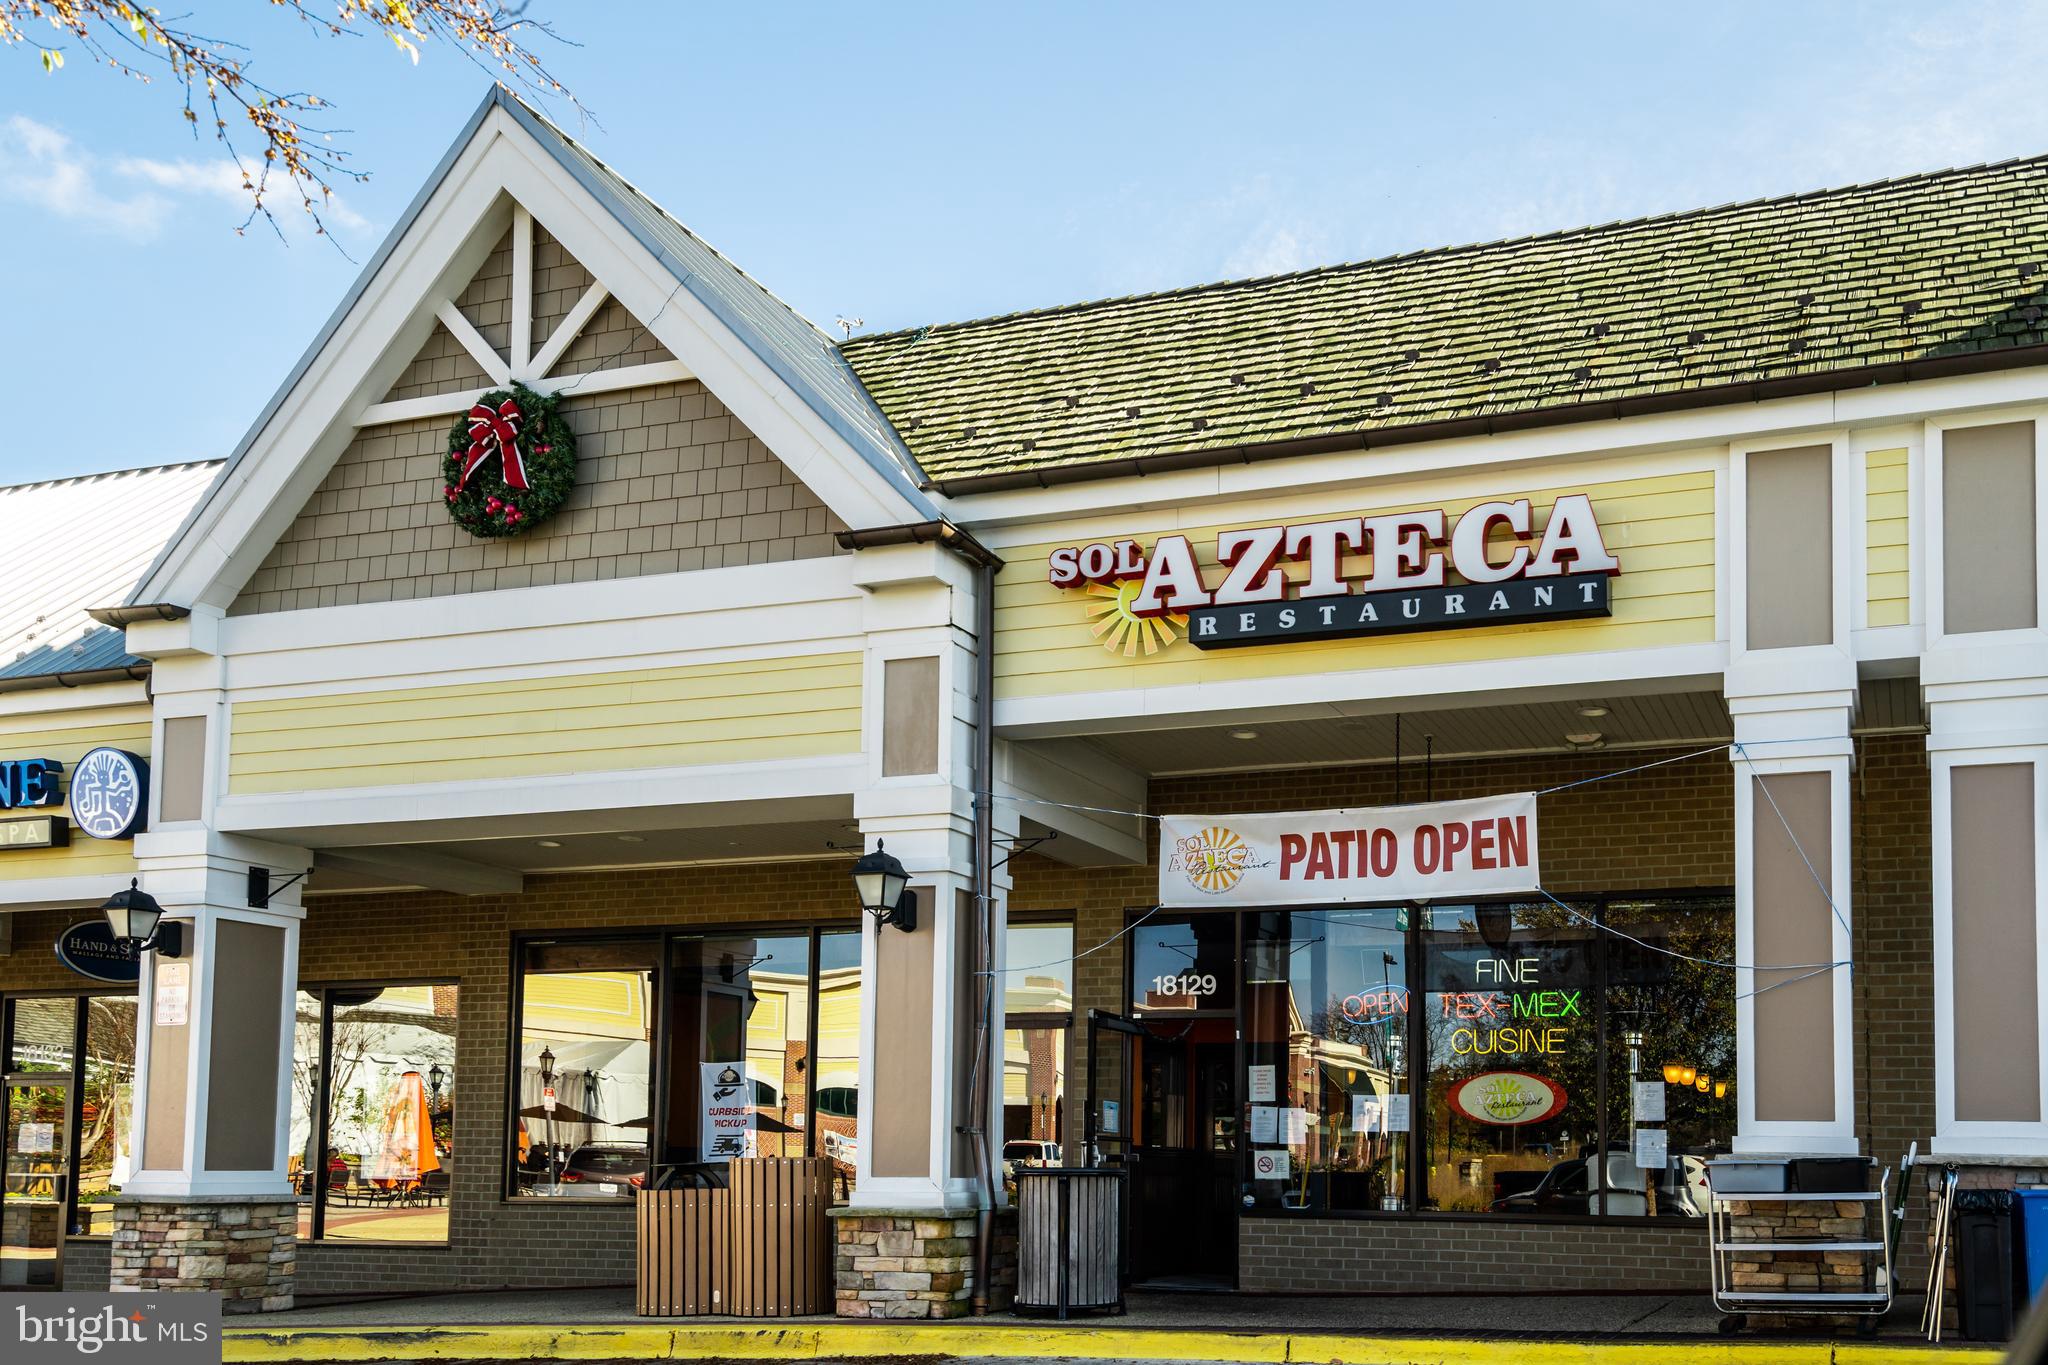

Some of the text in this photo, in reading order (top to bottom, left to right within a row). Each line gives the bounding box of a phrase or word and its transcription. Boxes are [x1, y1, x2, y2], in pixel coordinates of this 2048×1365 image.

[1049, 493, 1622, 613] SOL AZTECA
[1198, 582, 1599, 636] RESTAURANT
[1176, 836, 1212, 853] SOL
[1279, 816, 1529, 880] PATIO OPEN
[1168, 847, 1261, 872] AZTECA
[1476, 958, 1540, 983] FINE
[1152, 974, 1217, 996] 18129
[1342, 991, 1409, 1017] OPEN
[1438, 991, 1582, 1019] TEX-MEX
[1451, 1028, 1569, 1055] CUISINE
[714, 1119, 747, 1128] PICKUP
